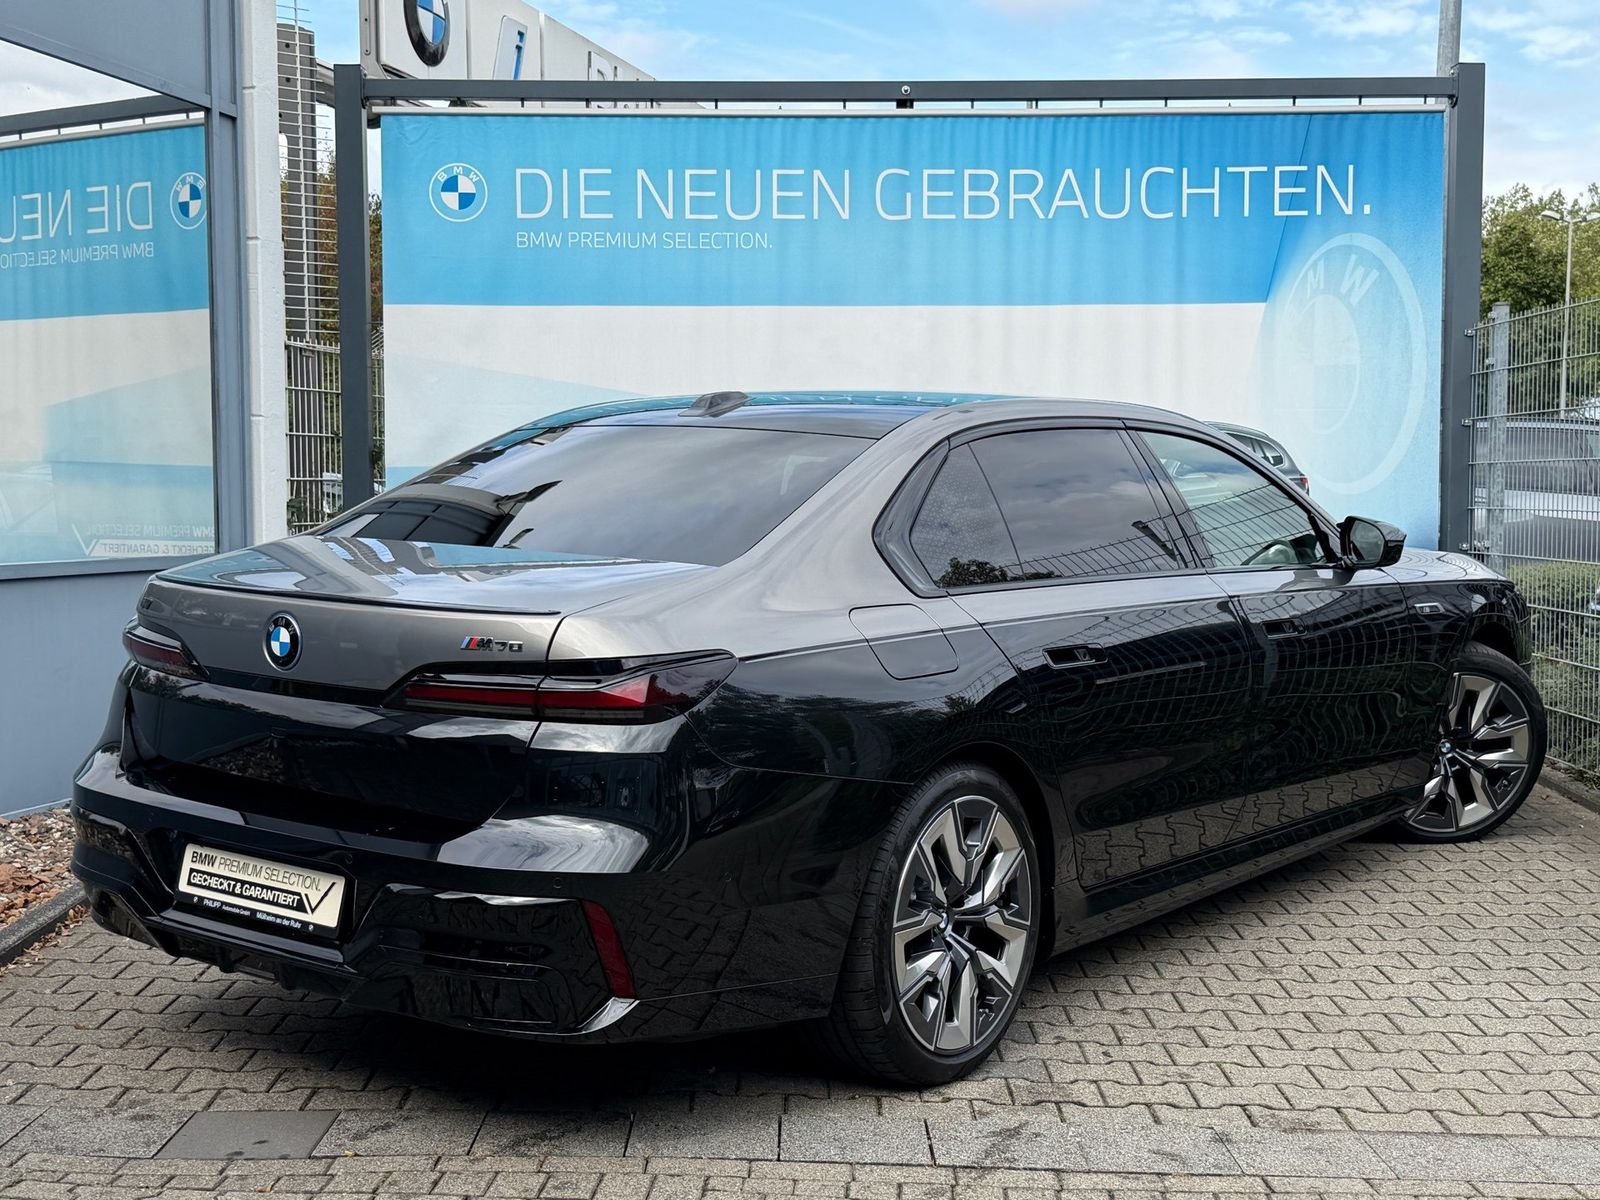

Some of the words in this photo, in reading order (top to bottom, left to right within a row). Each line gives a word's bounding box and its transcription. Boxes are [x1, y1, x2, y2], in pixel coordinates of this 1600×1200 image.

[437, 165, 481, 183] BMW
[515, 168, 614, 219] DIE
[636, 168, 850, 221] NEUEN
[875, 164, 1371, 221] GEBRAUCHTEN.
[516, 232, 562, 248] BMW
[568, 231, 657, 248] PREMIUM
[663, 231, 773, 249] SELECTION.
[190, 850, 217, 868] BMW
[217, 857, 263, 878] PREMIUM
[263, 867, 321, 892] SELECTION.
[190, 871, 236, 892] GECHECKT
[234, 882, 242, 895] &
[242, 884, 300, 907] GARANTIERT
[203, 898, 222, 908] PHILIPP
